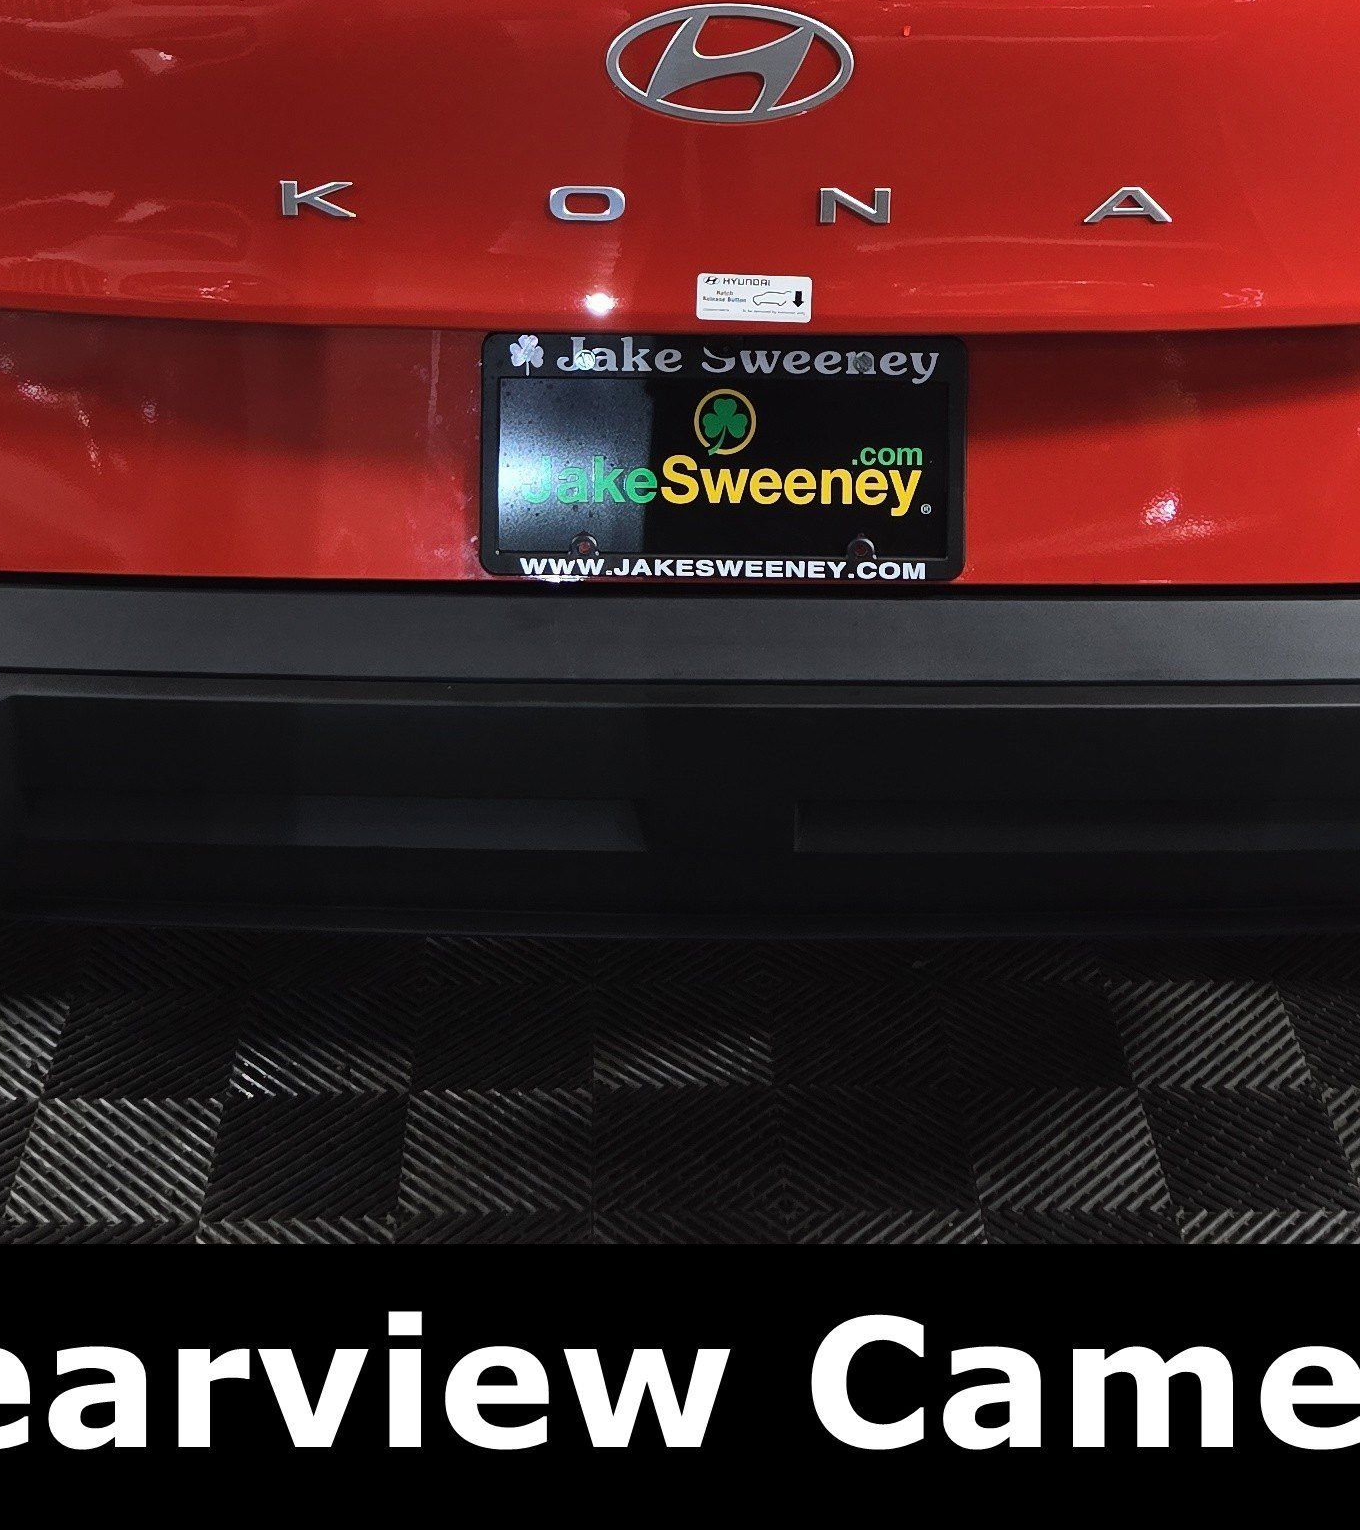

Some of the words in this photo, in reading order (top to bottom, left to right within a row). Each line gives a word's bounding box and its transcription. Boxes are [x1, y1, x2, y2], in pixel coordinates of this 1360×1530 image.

[279, 178, 1172, 225] KONA
[722, 277, 771, 287] HYUNDAI
[556, 336, 683, 372] Jake
[701, 346, 940, 385] Sweeney
[851, 446, 923, 466] .com
[519, 557, 926, 580] WWW.JAKESWEENEY.COM
